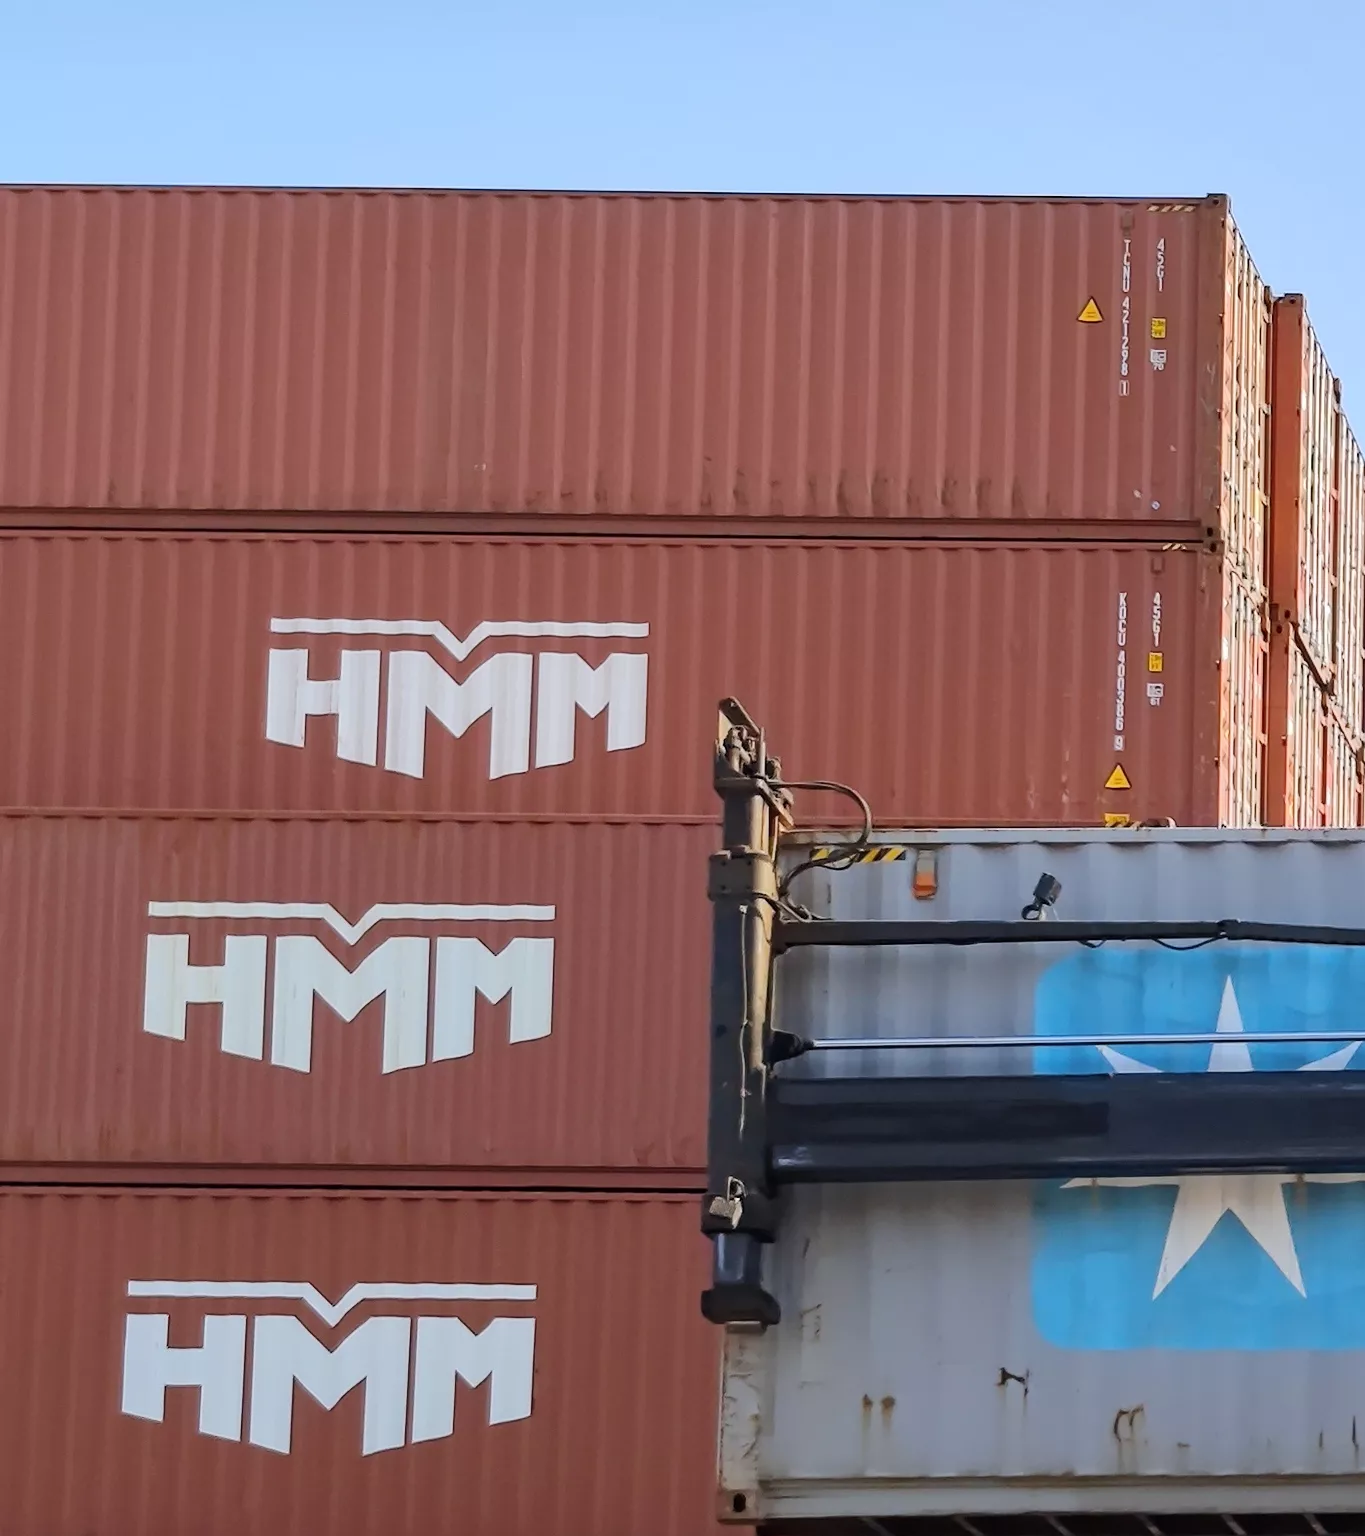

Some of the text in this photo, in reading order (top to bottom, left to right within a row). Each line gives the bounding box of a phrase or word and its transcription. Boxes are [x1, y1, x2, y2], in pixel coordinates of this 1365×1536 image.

[1122, 239, 1132, 293] TCNU
[1156, 238, 1166, 292] 45G1
[1117, 592, 1128, 647] KOCU
[1152, 591, 1161, 647] 45G1
[265, 646, 649, 781] HMM
[143, 931, 555, 1075] HMM
[120, 1311, 537, 1457] HMM
